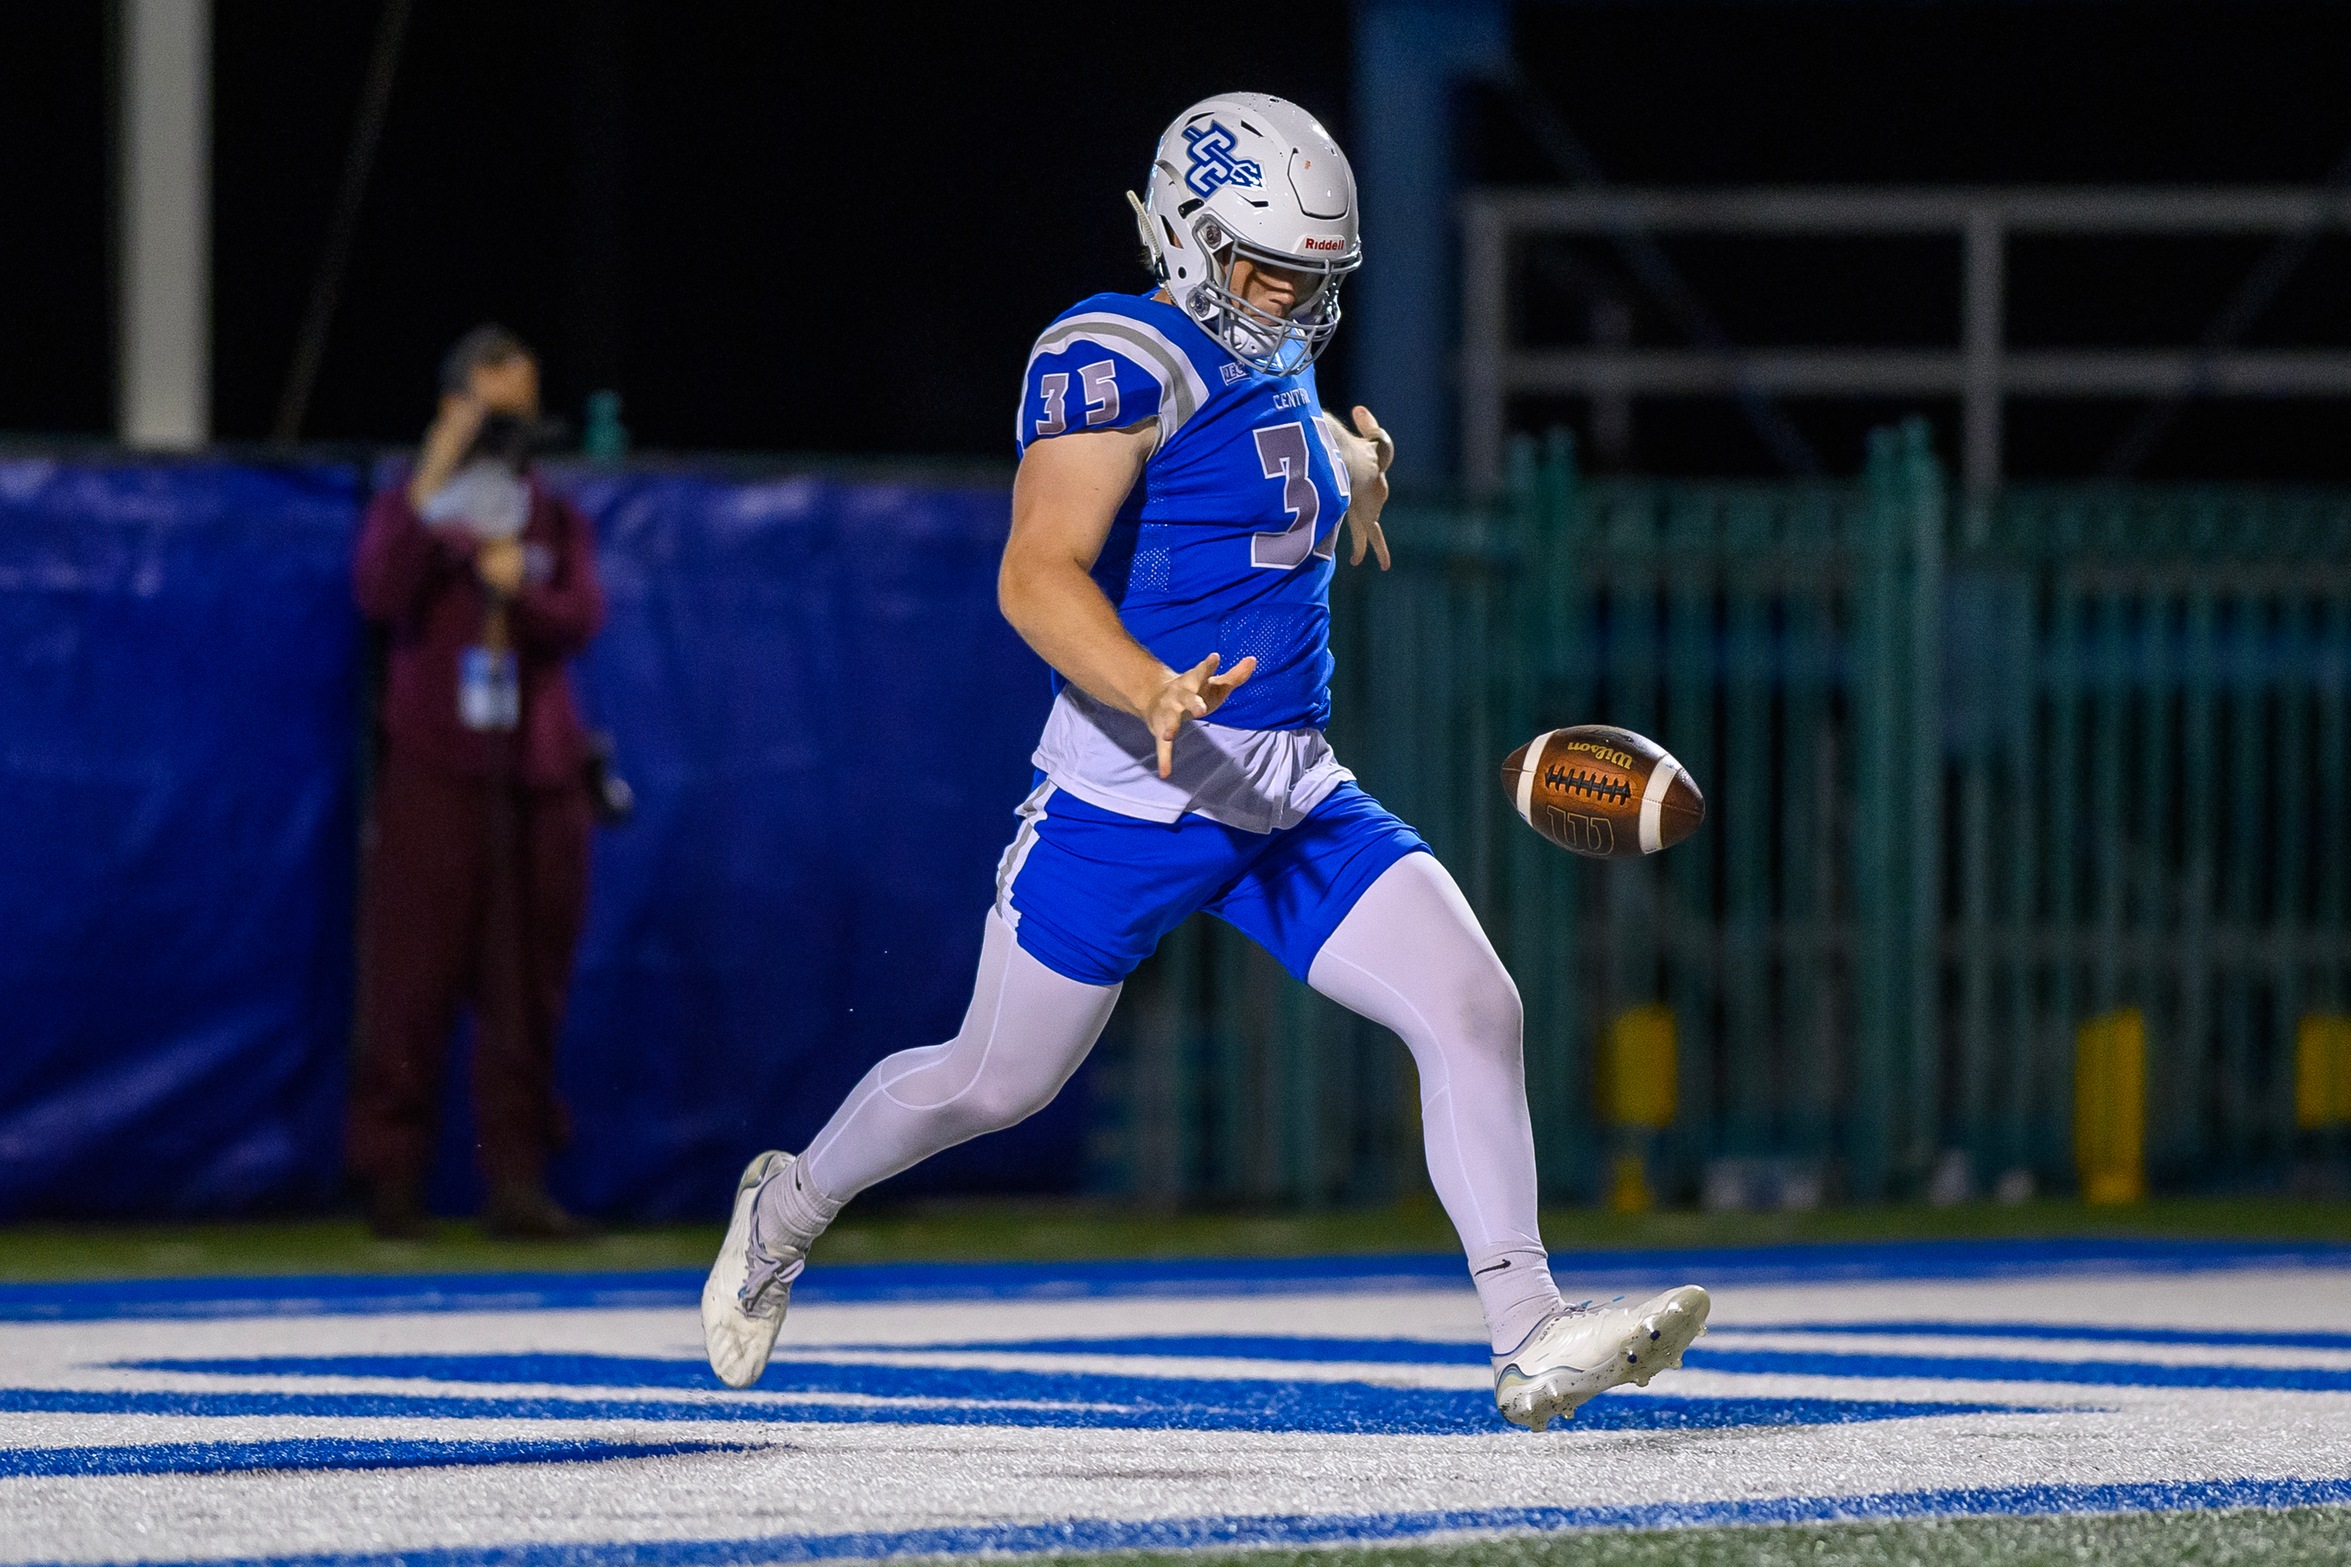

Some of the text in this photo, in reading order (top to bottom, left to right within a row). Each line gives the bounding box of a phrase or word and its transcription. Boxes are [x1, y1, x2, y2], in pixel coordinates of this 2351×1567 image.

[1305, 238, 1345, 250] Riddell
[1035, 359, 1120, 435] 35
[1273, 388, 1311, 410] CENTR
[1567, 742, 1633, 770] Wilson
